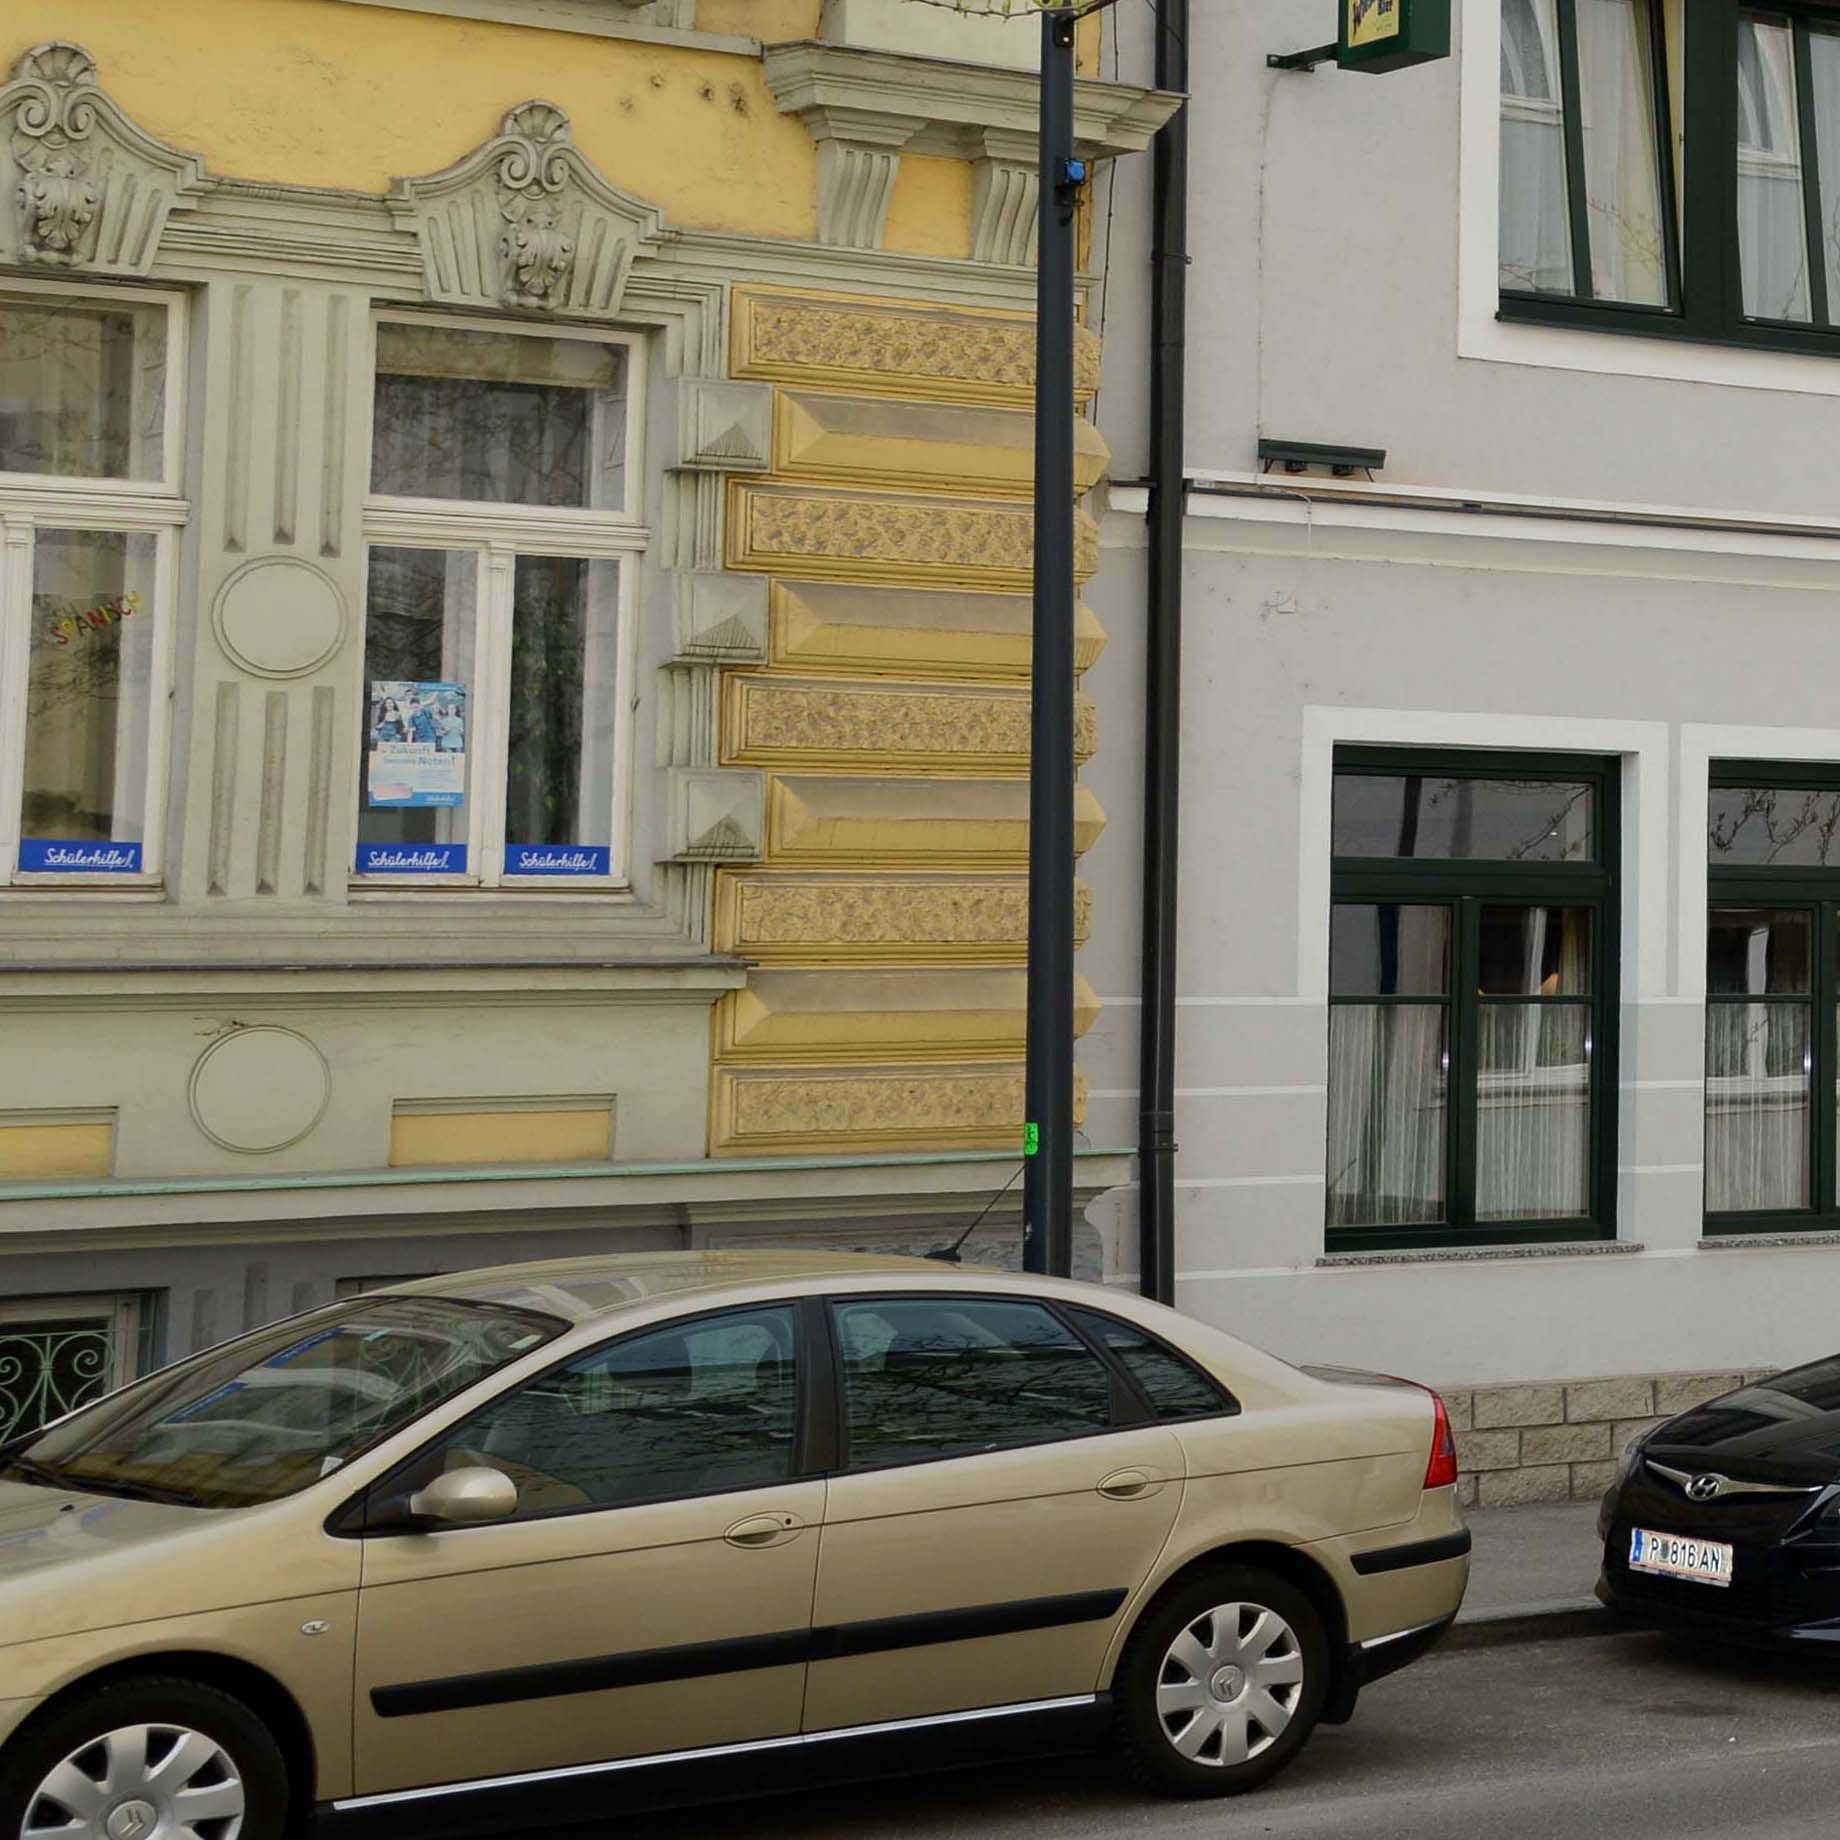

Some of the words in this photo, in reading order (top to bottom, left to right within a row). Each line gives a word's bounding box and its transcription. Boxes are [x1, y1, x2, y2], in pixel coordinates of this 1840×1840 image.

[44, 847, 135, 869] Schülerhilfe!
[368, 850, 449, 869] Schülerhilfe!
[520, 851, 597, 871] Schülerhilfe!
[1650, 1537, 1660, 1560] P
[1670, 1541, 1696, 1568] 816
[1700, 1546, 1720, 1572] AN
